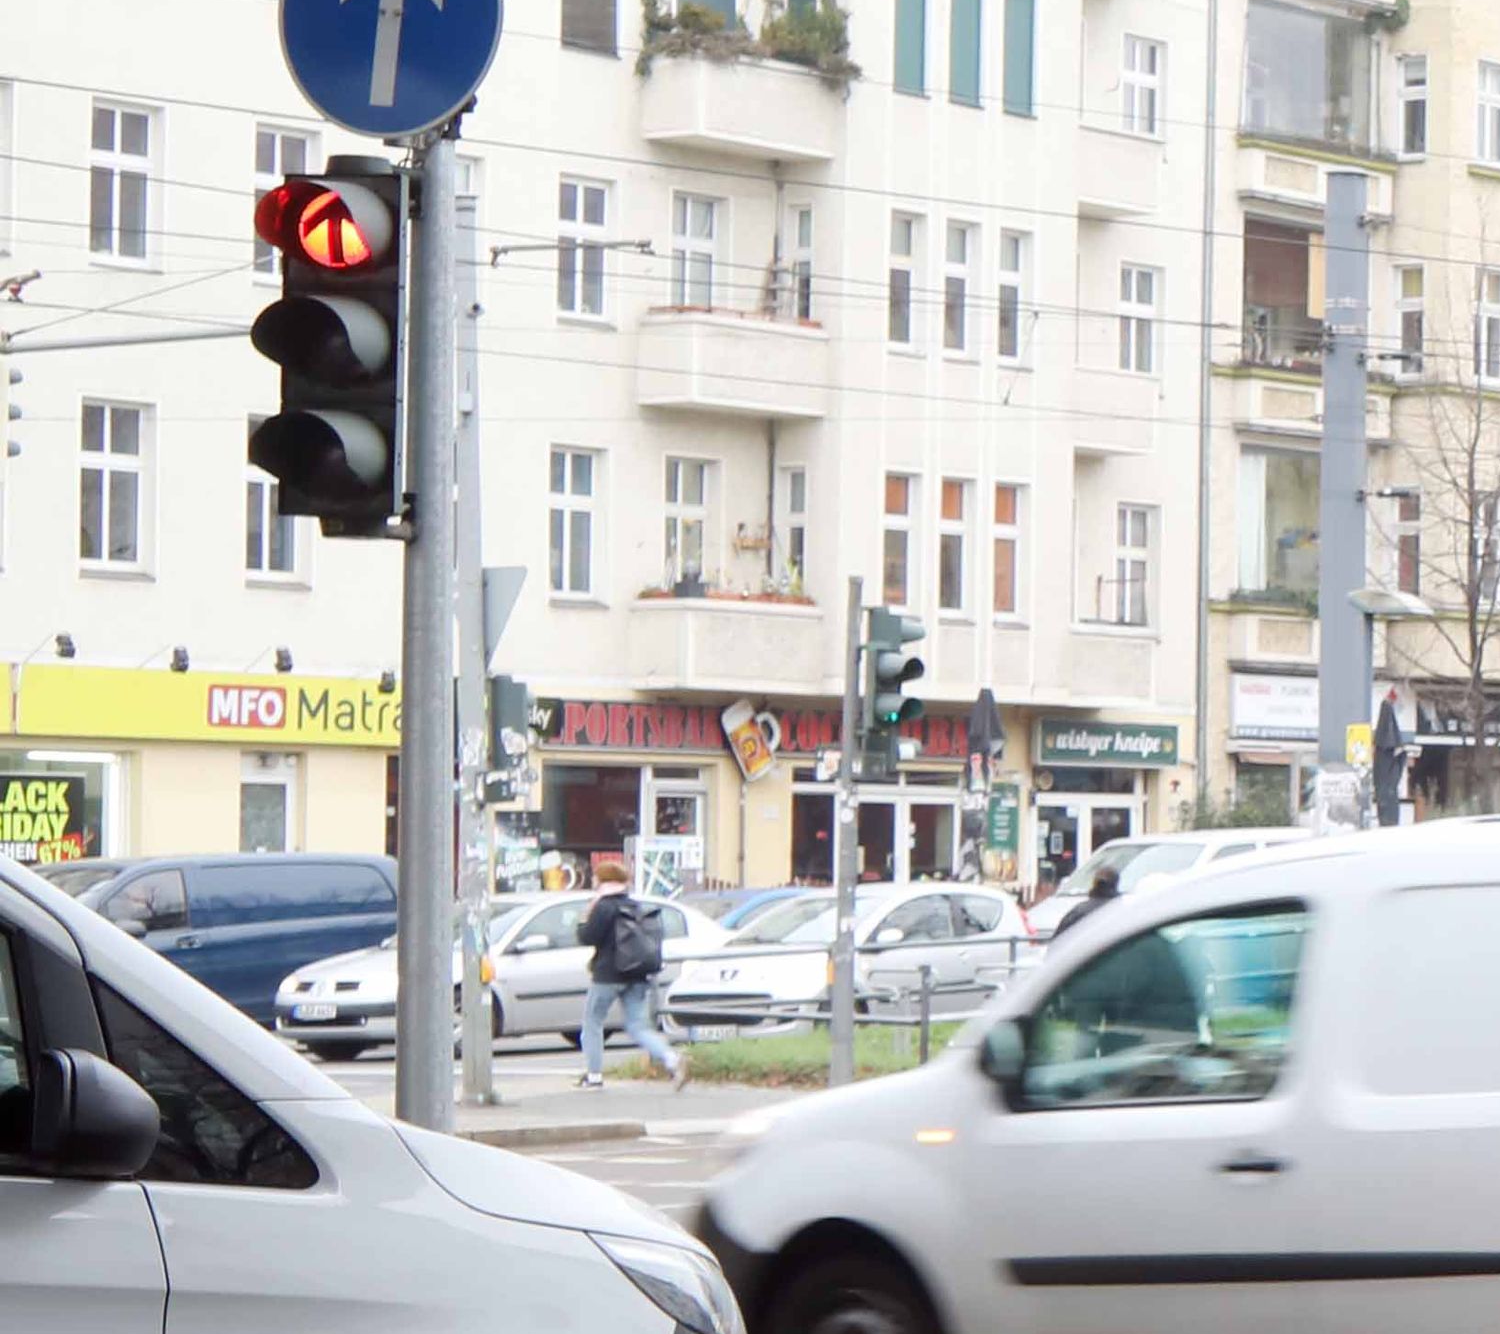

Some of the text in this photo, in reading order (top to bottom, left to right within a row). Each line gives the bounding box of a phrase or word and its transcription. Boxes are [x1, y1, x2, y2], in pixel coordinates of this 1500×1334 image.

[211, 688, 284, 727] MFO
[549, 701, 722, 749] PORTSBAR
[1114, 730, 1161, 758] kneipe
[0, 780, 70, 814] ACK
[0, 813, 70, 843] IDAY
